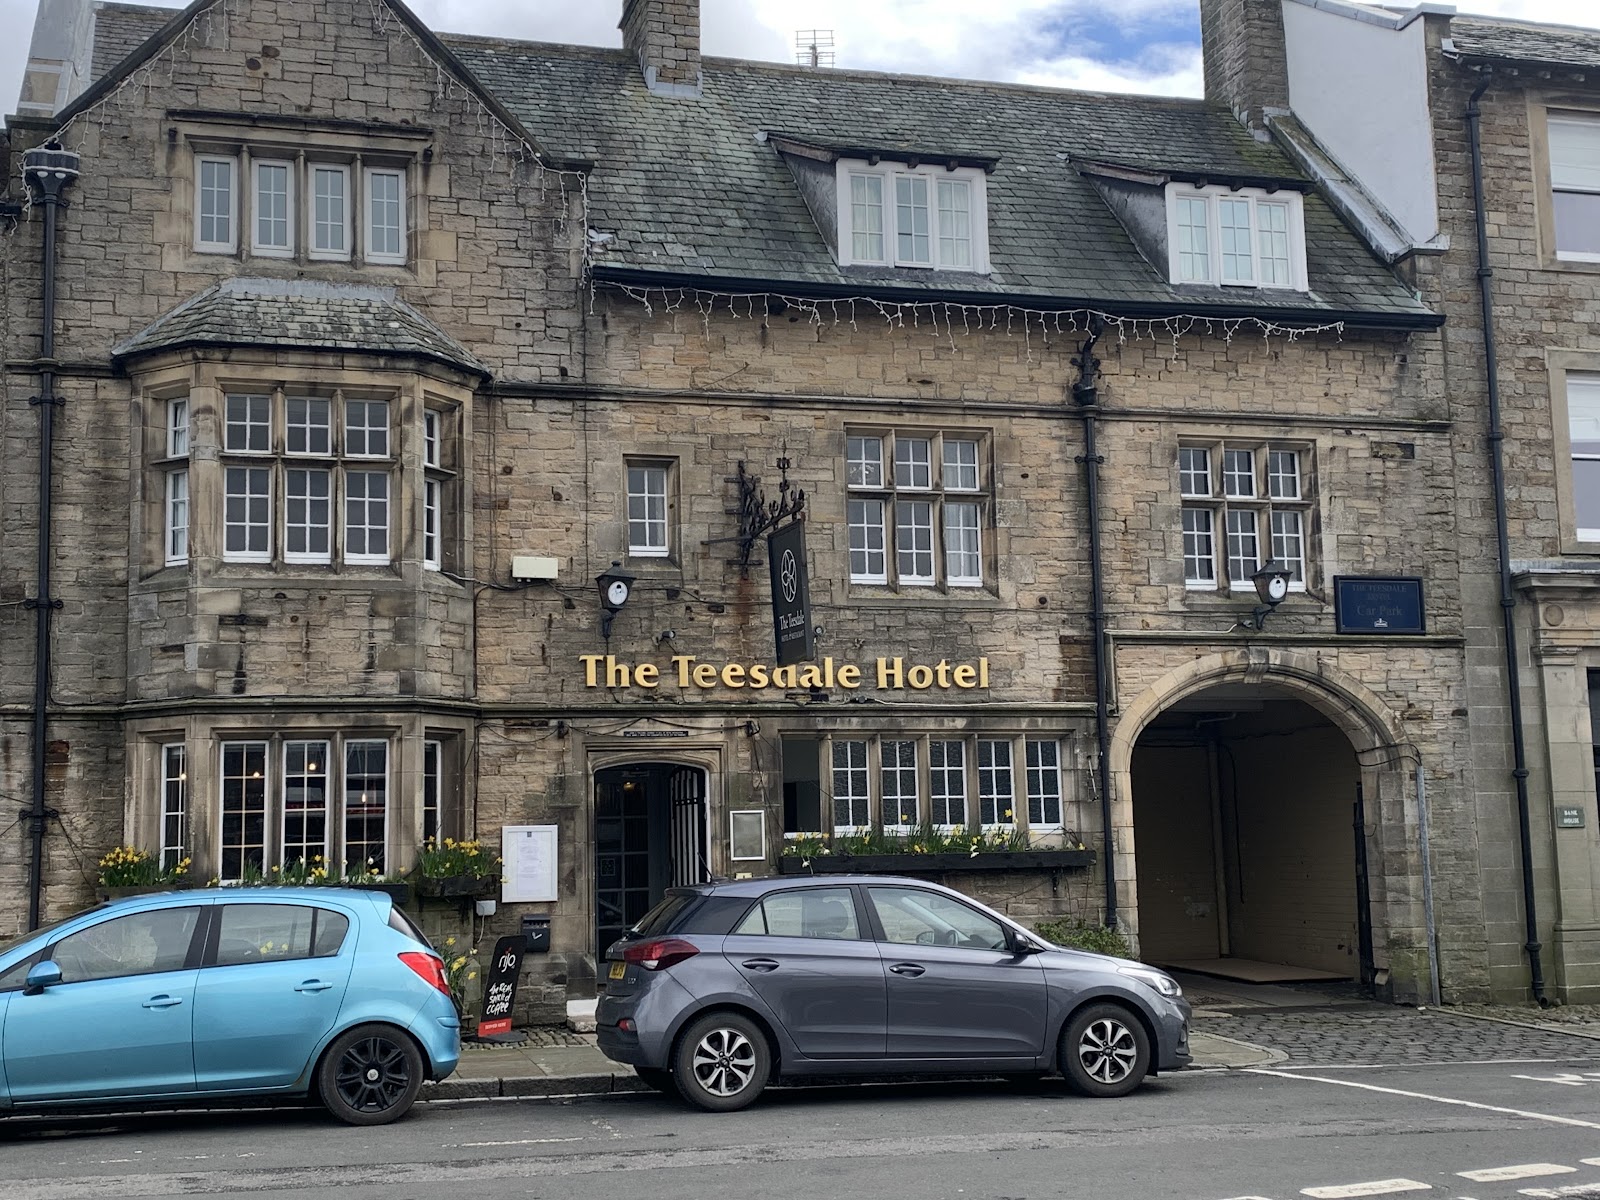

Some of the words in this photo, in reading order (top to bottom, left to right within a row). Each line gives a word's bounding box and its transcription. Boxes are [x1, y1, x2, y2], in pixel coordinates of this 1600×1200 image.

[1356, 605, 1377, 616] Car
[1379, 604, 1404, 616] Park
[779, 615, 788, 630] The
[579, 654, 660, 689] The
[671, 654, 862, 690] Teesdale
[876, 656, 990, 690] Hotel
